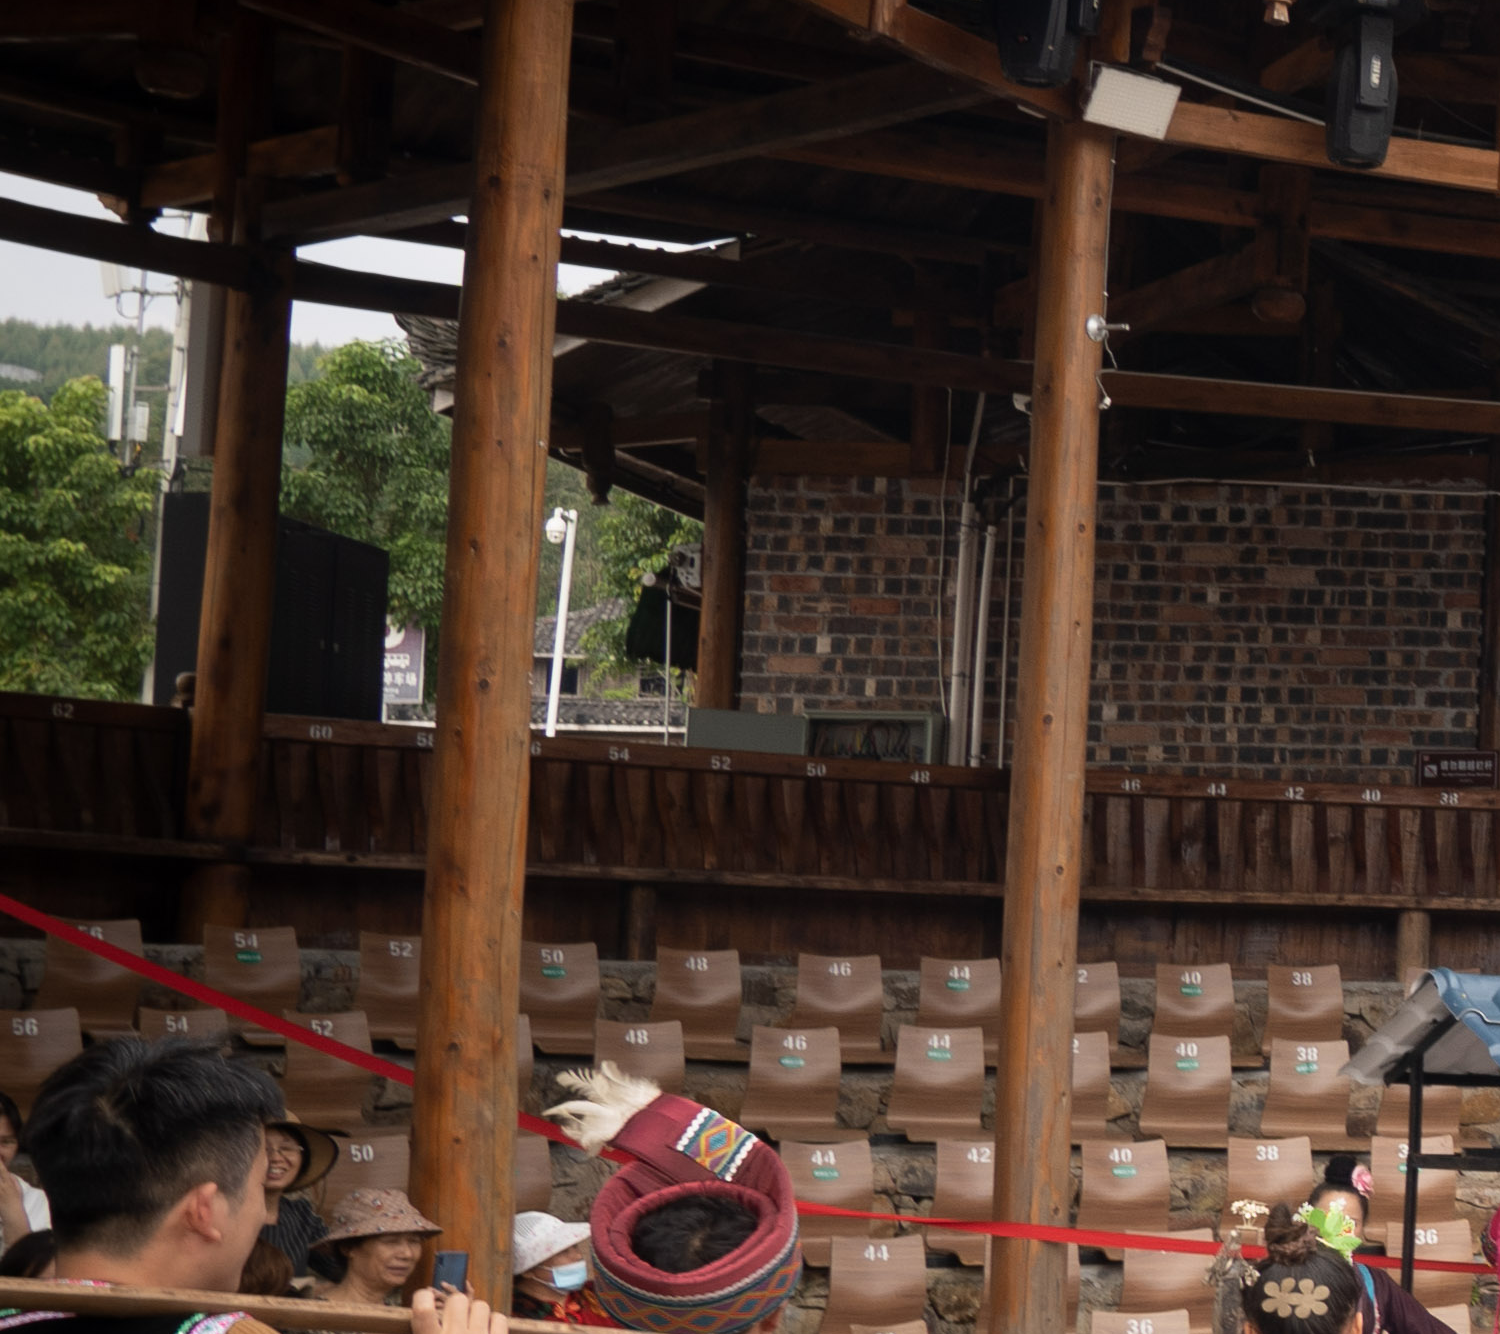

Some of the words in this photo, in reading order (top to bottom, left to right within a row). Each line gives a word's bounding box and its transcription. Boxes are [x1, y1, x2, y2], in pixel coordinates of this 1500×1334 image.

[310, 726, 332, 738] 60
[531, 742, 541, 754] 6
[609, 747, 630, 761] 54
[711, 756, 731, 770] 52
[807, 763, 826, 776] 50
[910, 771, 930, 783] 48
[1121, 779, 1140, 791] 46
[1207, 783, 1226, 795] 44
[1285, 787, 1304, 800] 42
[1362, 790, 1381, 802] 40
[1440, 793, 1458, 805] 38
[234, 933, 258, 948] 54
[389, 941, 412, 957] 52
[541, 949, 564, 963] 50
[686, 957, 708, 971] 48
[829, 963, 851, 976] 46
[949, 967, 970, 979] 44
[1181, 972, 1201, 984] 40
[1293, 972, 1312, 985] 38
[14, 1018, 38, 1035] 56
[166, 1016, 188, 1032] 54
[311, 1020, 333, 1036] 52
[626, 1030, 648, 1044] 48
[784, 1036, 807, 1050] 46
[929, 1035, 950, 1048] 44
[1176, 1043, 1197, 1056] 40
[1297, 1047, 1317, 1061] 38
[351, 1145, 374, 1162] 50
[812, 1151, 835, 1165] 44
[967, 1148, 991, 1163] 42
[1110, 1148, 1132, 1162] 40
[1256, 1146, 1279, 1160] 38
[1416, 1229, 1438, 1244] 36
[865, 1245, 889, 1260] 44
